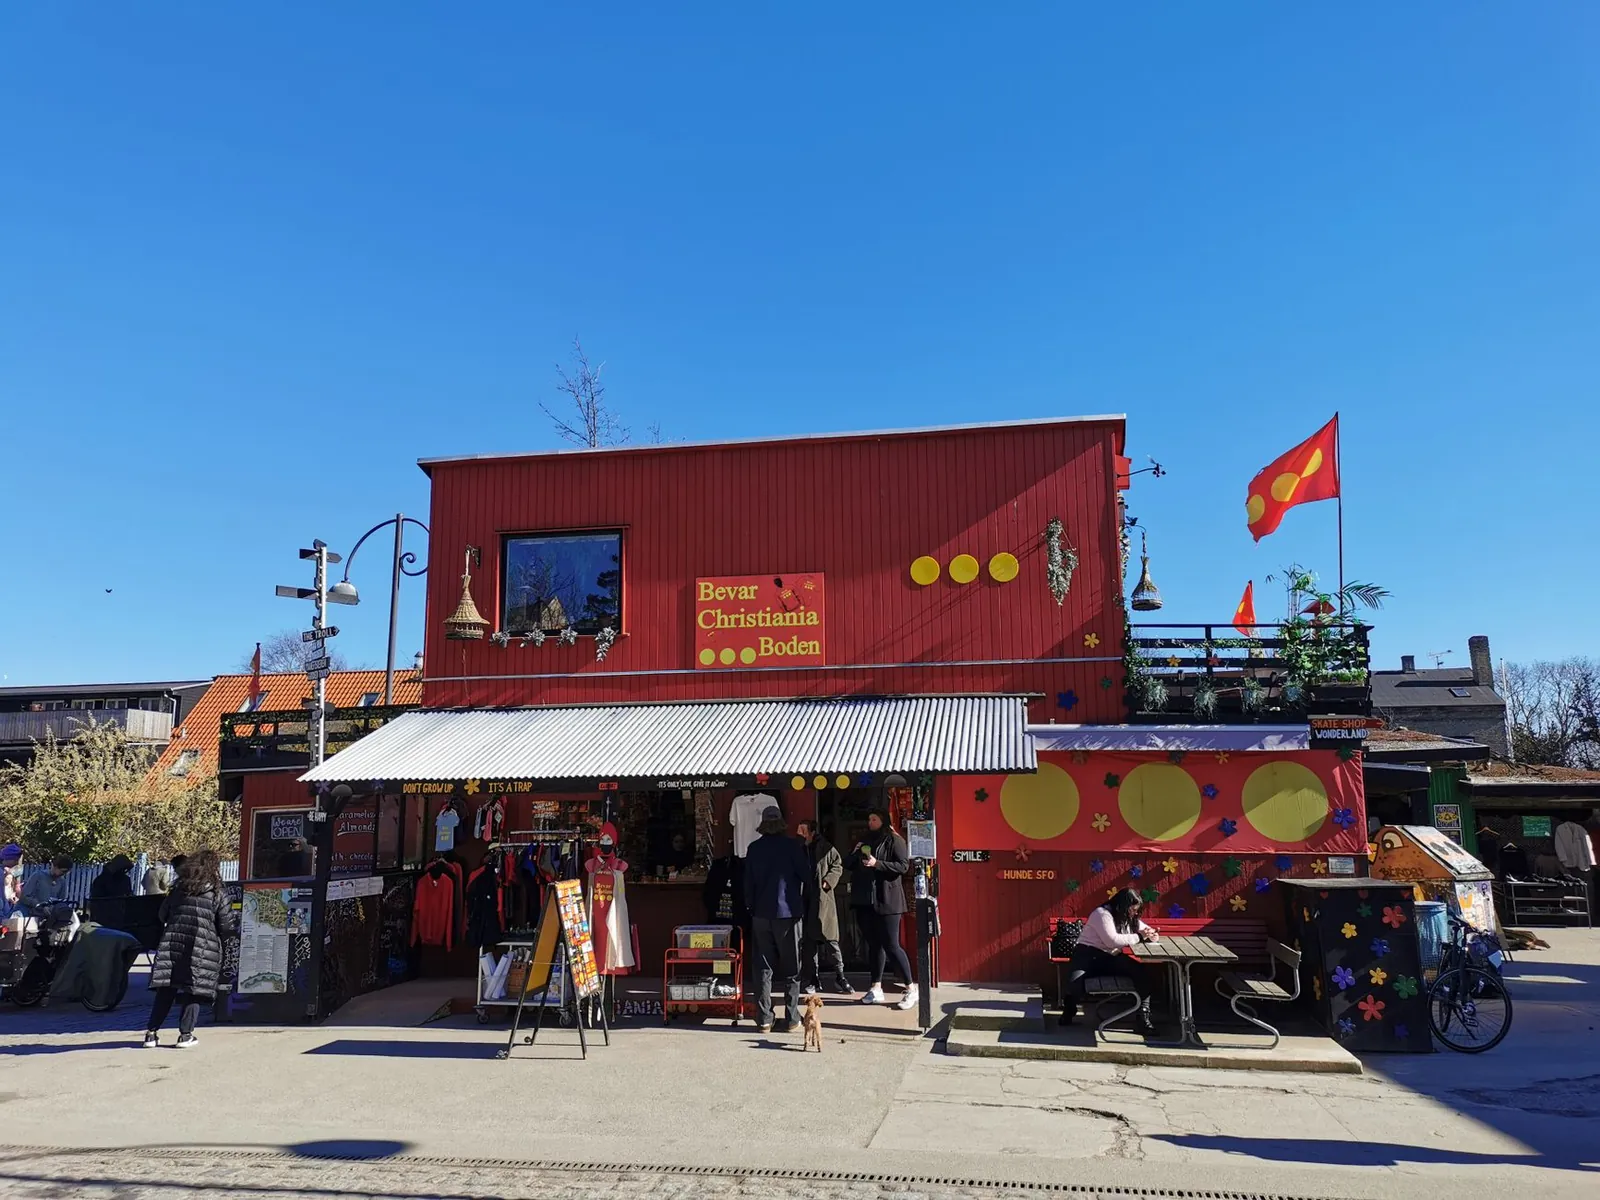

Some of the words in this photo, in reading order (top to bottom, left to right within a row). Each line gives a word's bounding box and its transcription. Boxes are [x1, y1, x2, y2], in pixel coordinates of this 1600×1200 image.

[698, 582, 758, 601] Bevar
[697, 606, 819, 629] Christiania
[304, 632, 314, 640] THE
[315, 629, 333, 639] TROLL
[758, 635, 820, 656] Boden
[1312, 719, 1338, 729] SKATE
[1342, 719, 1367, 729] SHOP
[1315, 728, 1367, 739] WONDERLAND
[422, 783, 444, 793] GROW
[444, 783, 454, 793] UP
[488, 782, 504, 793] IT'S
[506, 783, 512, 793] A
[514, 781, 533, 792] TRAP
[272, 826, 301, 838] OPEN
[954, 850, 983, 862] SMILE
[1004, 869, 1033, 880] HUNDE
[1036, 870, 1055, 880] SFO
